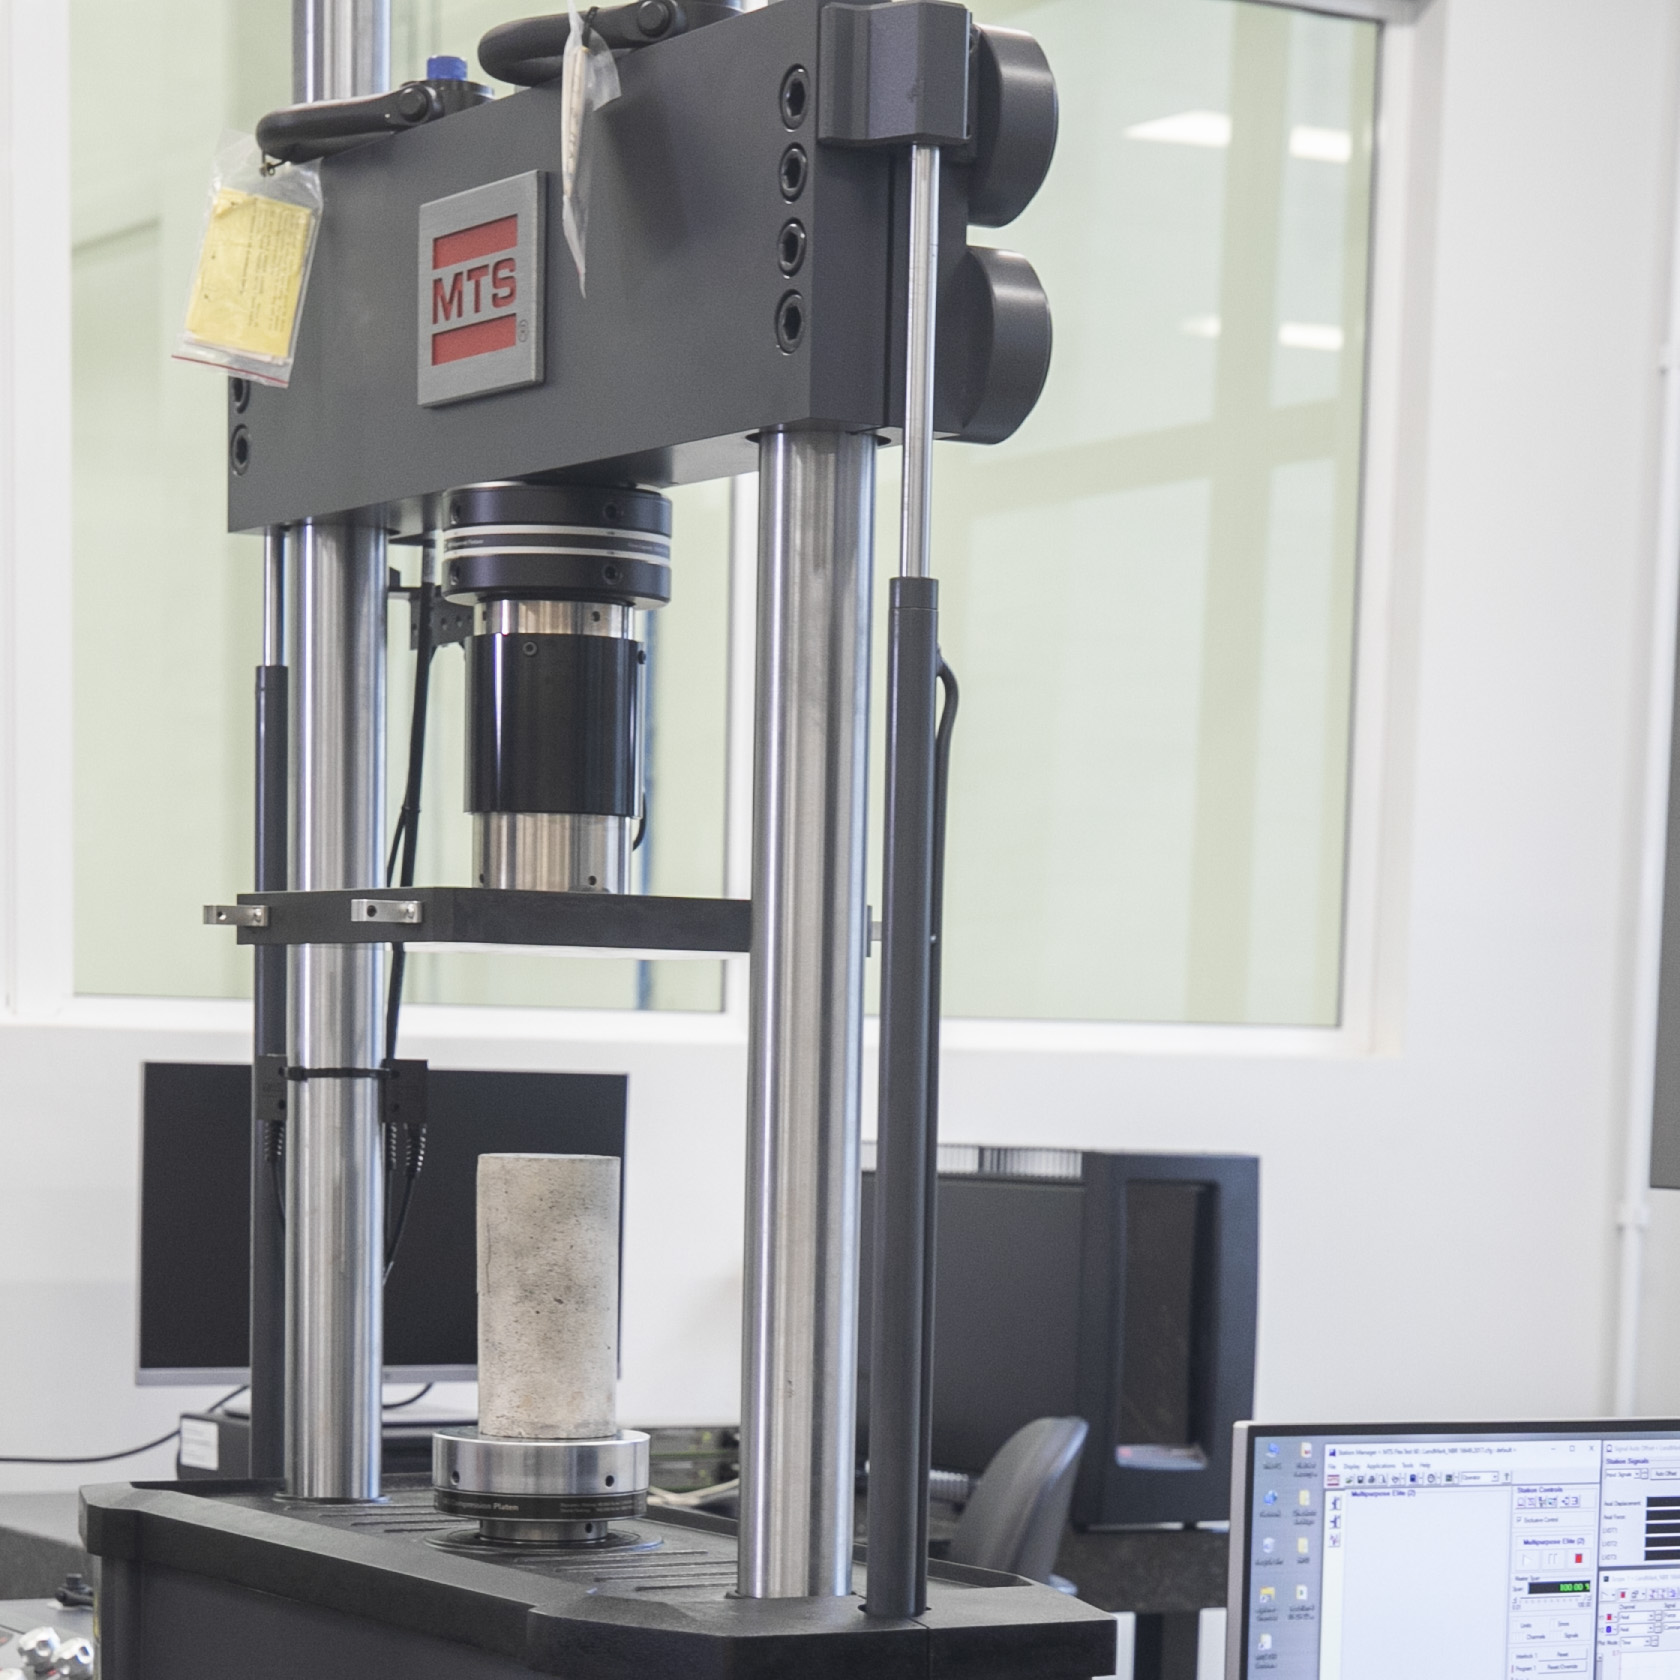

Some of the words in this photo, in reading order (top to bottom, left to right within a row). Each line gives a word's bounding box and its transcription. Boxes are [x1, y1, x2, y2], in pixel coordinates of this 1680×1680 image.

[431, 256, 518, 325] MTS
[1351, 1490, 1391, 1498] Multipurpose
[1523, 1539, 1561, 1547] Multipurpose
